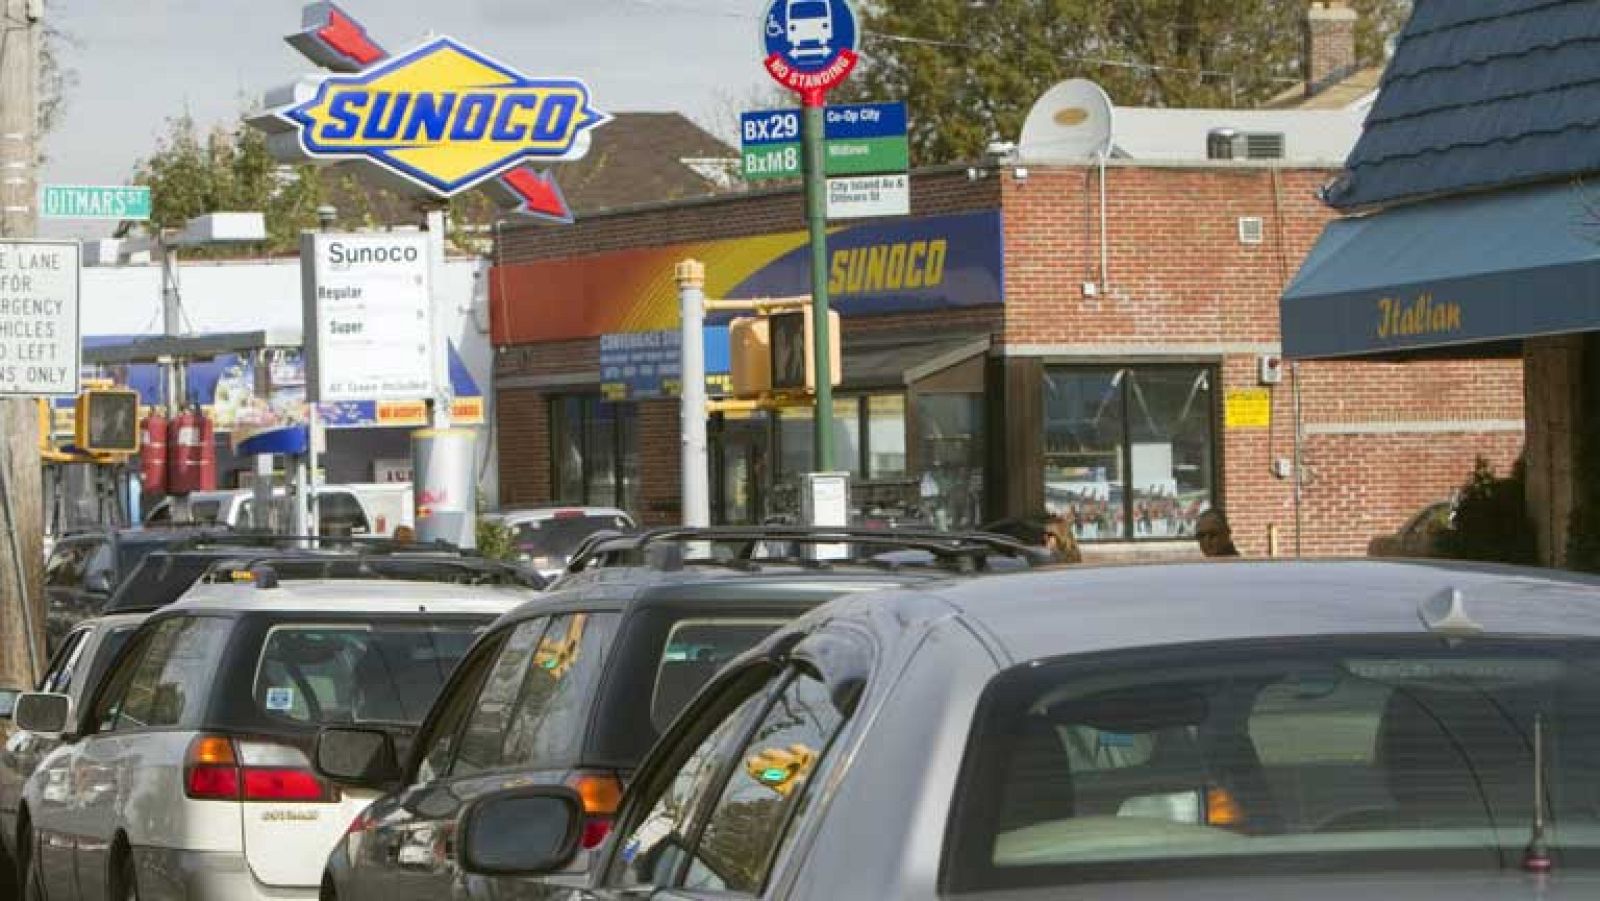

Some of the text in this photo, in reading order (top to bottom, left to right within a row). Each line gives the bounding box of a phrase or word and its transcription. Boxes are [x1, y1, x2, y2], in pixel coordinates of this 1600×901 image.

[771, 56, 849, 87] NO STANDING
[320, 91, 578, 142] SUNOCO
[826, 107, 880, 123] Co-Op City
[745, 147, 797, 173] BxM8
[47, 189, 125, 215] DITMARS
[18, 252, 60, 270] LANE
[328, 242, 418, 264] Sunoco
[829, 240, 948, 295] SUNOCO
[1, 274, 32, 293] FOR
[318, 286, 362, 301] Regular
[1376, 293, 1462, 338] Italian
[330, 320, 362, 335] Super
[18, 343, 56, 361] LEFT
[27, 366, 67, 385] ONLY
